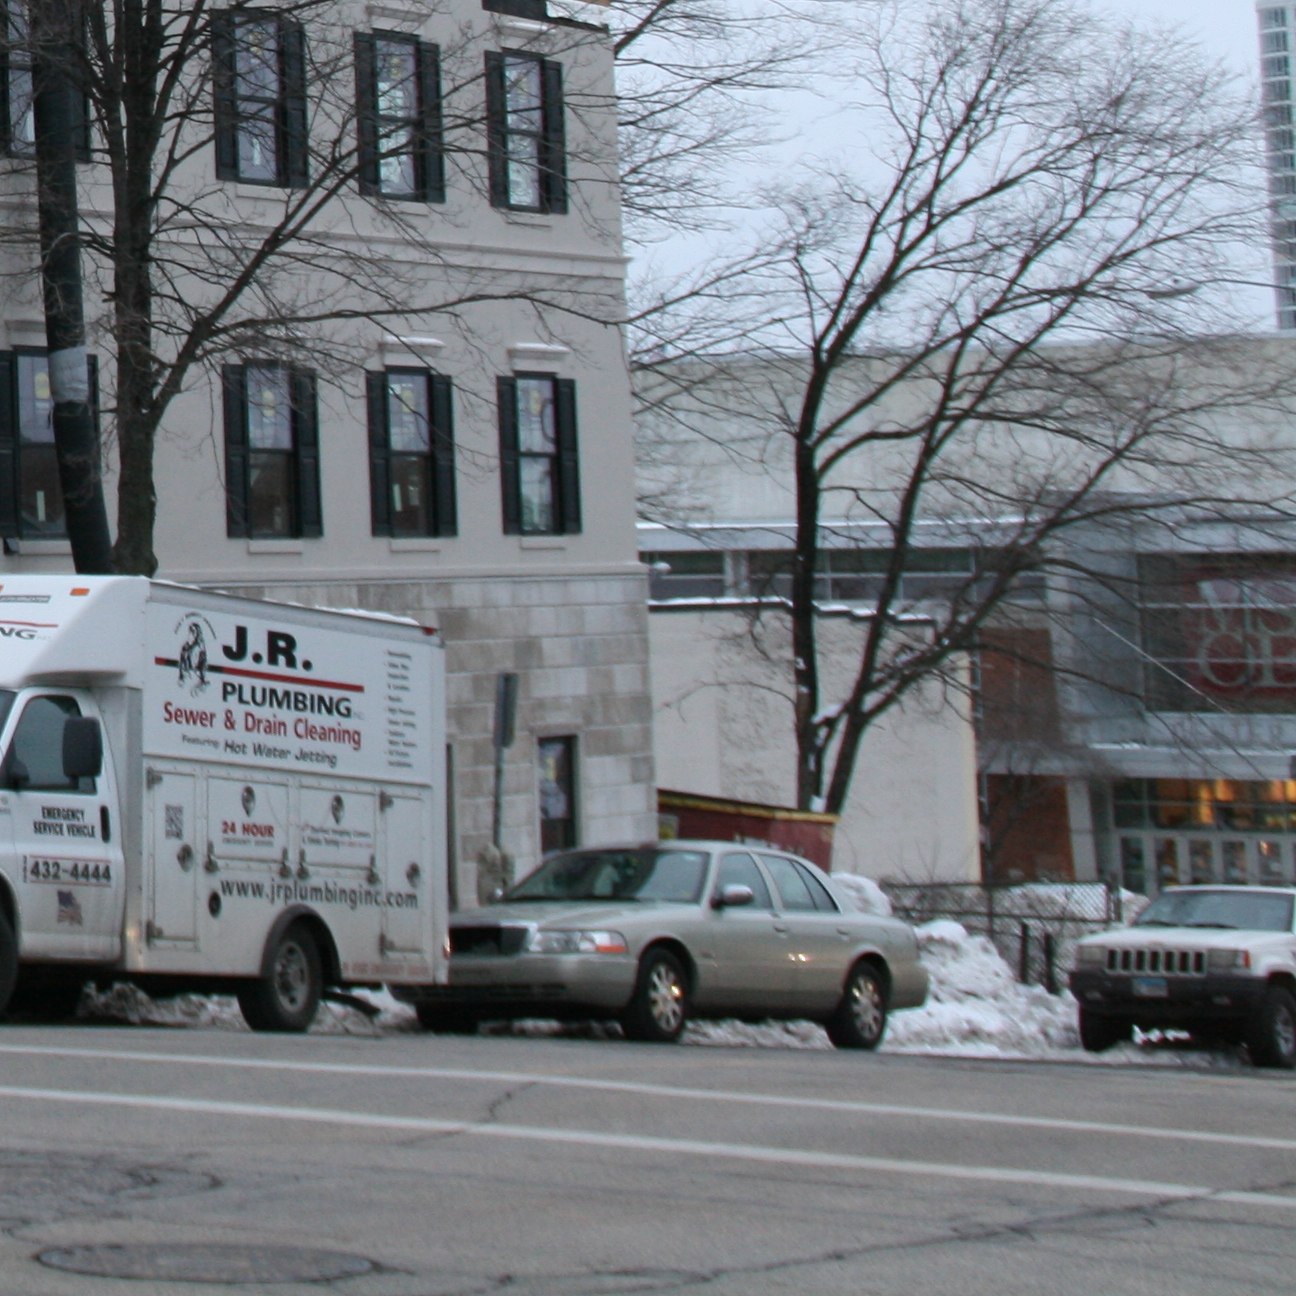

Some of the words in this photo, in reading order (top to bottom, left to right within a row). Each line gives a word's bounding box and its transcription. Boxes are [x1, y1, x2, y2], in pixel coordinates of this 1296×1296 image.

[222, 625, 312, 671] J.R.
[222, 681, 351, 718] PLUMBING
[163, 701, 216, 728] Sewer
[224, 710, 236, 730] &
[244, 711, 287, 736] Drain
[294, 718, 361, 750] Cleaning
[224, 740, 246, 755] Hot
[253, 743, 291, 760] Water
[295, 748, 337, 768] Jetting
[41, 806, 85, 822] EMERGENCY
[33, 821, 64, 836] SERVICE
[67, 824, 95, 838] VEHICLE
[222, 821, 237, 833] 24
[242, 823, 274, 838] HOUR
[30, 860, 111, 882] 432-4444
[220, 879, 419, 910] www.jrplumbinginc.com
